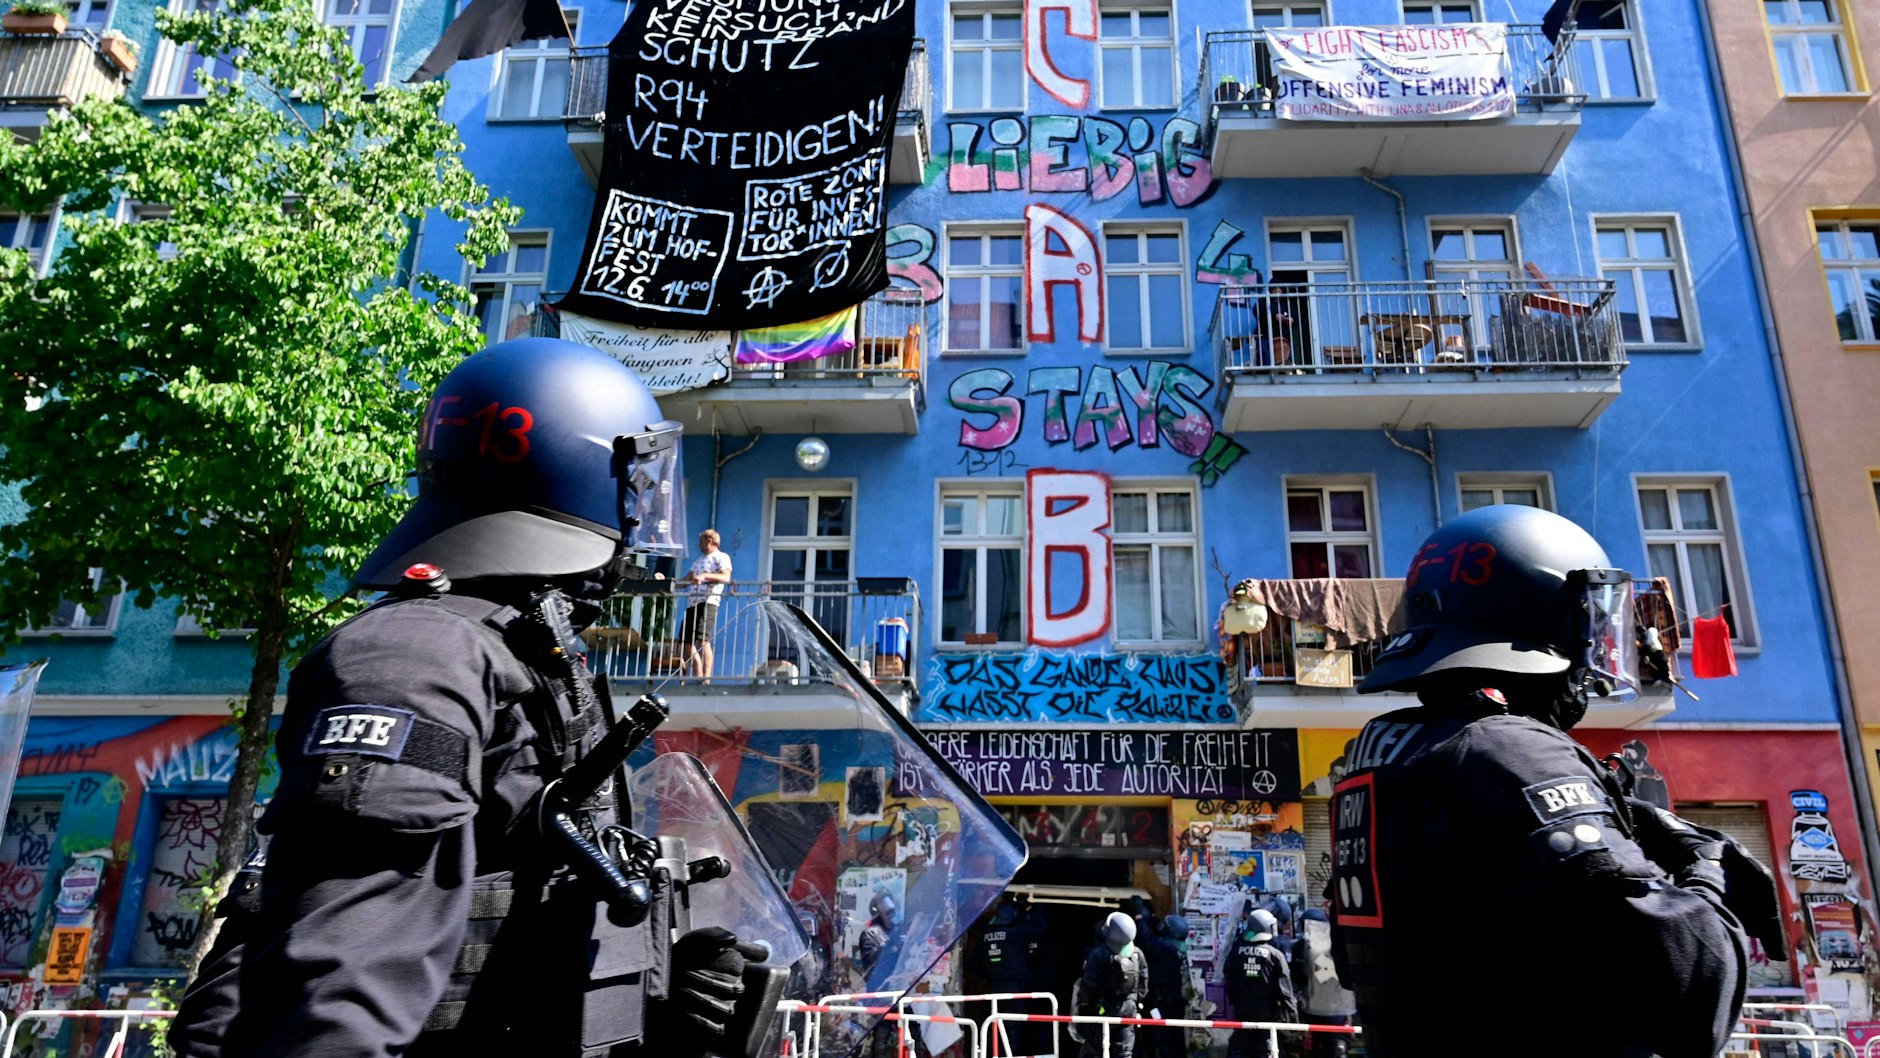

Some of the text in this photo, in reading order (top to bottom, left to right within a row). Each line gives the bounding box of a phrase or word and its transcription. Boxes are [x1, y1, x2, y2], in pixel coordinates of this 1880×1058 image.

[646, 7, 741, 40] KEIN
[638, 32, 820, 73] SCHUTZ
[1303, 28, 1469, 55] FIGHT FASCISM
[1357, 63, 1431, 80] for more
[1400, 76, 1508, 97] FEMINISM
[634, 73, 709, 121] R94
[626, 95, 886, 170] VERTEIDIGEN!
[753, 180, 813, 209] ROTE
[610, 196, 698, 236] KOMMT
[749, 207, 800, 232] FÜR
[603, 221, 718, 261] ZUM HOF-
[597, 241, 666, 276] FEST
[584, 330, 714, 355] Freiheit für alle
[319, 714, 398, 746] BFE
[979, 732, 1092, 761] LEIDENSCHAFT
[1144, 733, 1171, 764] DIE
[1182, 732, 1272, 768] FREIHEIT
[899, 762, 923, 792] IST
[1020, 760, 1053, 792] ALS
[1063, 763, 1105, 792] JEDE
[1121, 763, 1227, 795] AUTORITÄT
[1537, 782, 1597, 813] BFE
